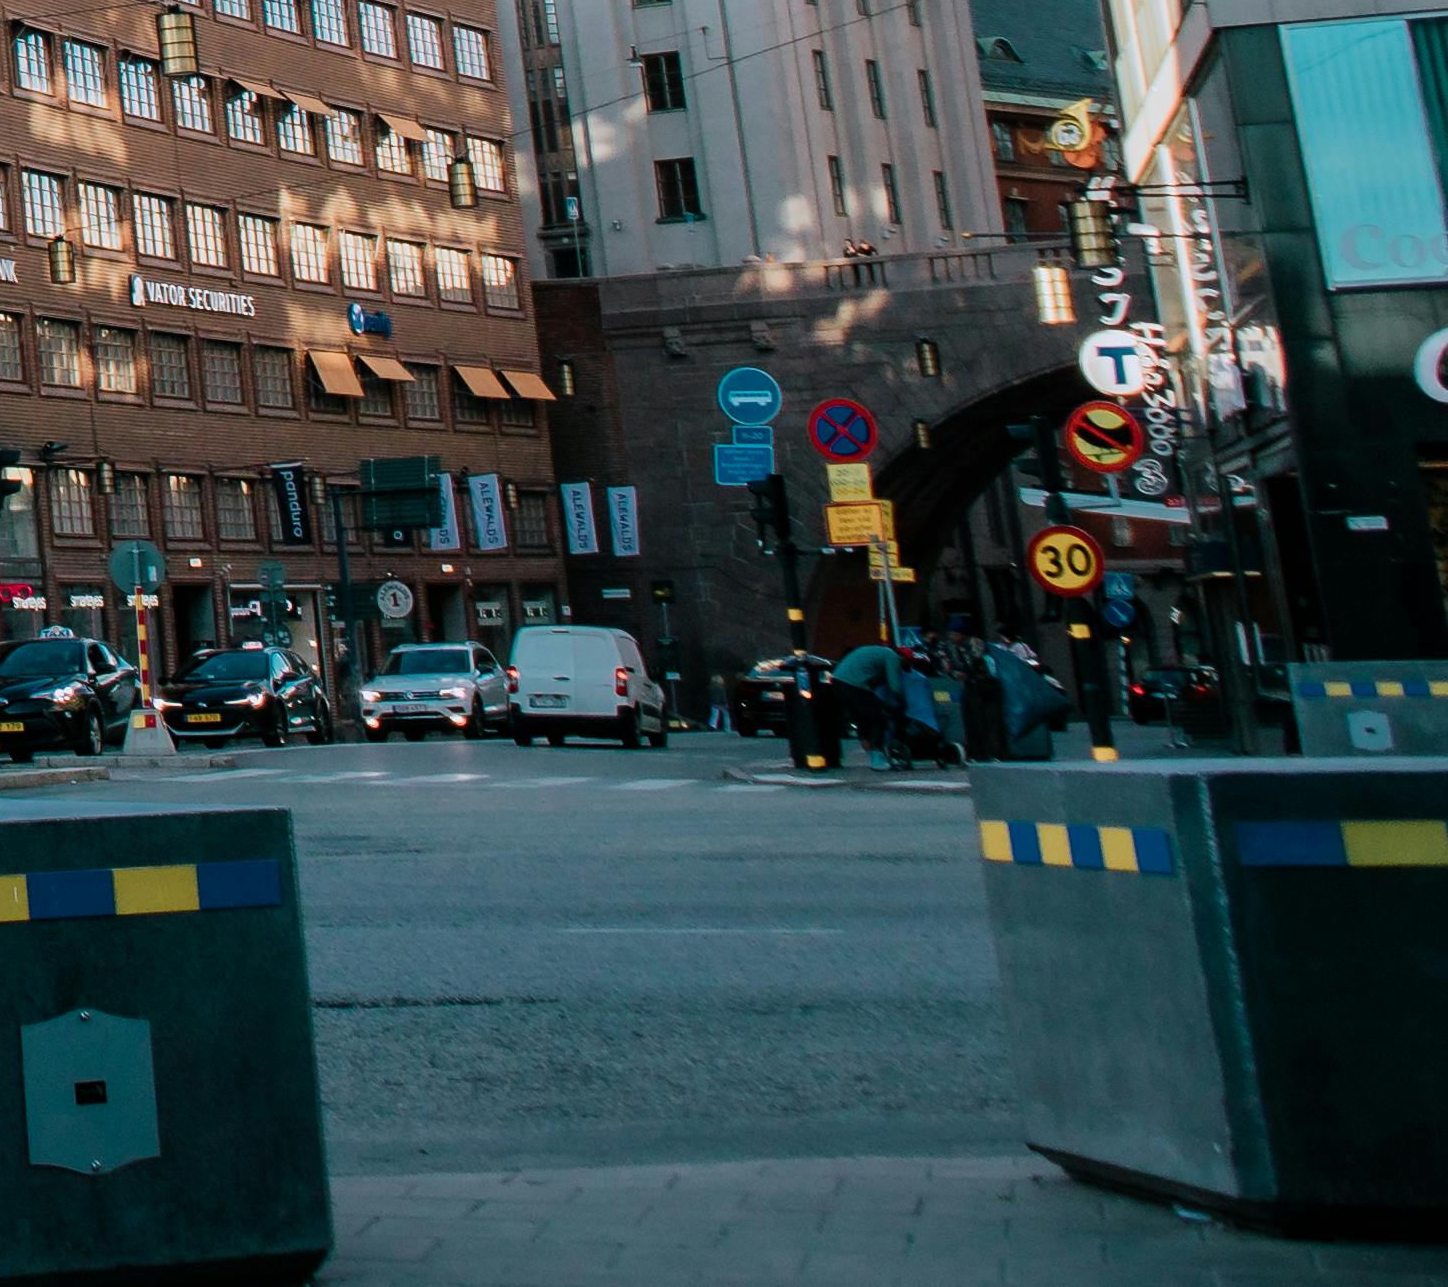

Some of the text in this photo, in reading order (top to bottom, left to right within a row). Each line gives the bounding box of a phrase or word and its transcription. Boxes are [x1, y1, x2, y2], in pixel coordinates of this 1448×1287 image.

[145, 280, 256, 318] VATOR SECURITIES
[1096, 346, 1137, 385] T
[280, 469, 304, 539] panduro
[478, 480, 499, 545] ALEWALDS
[571, 488, 588, 550] ALEWALDS
[616, 492, 632, 552] ALEWALDS
[1041, 543, 1092, 579] 30
[12, 596, 47, 611] smarteyes
[70, 594, 104, 609] smarteyes
[42, 629, 72, 639] TAXI
